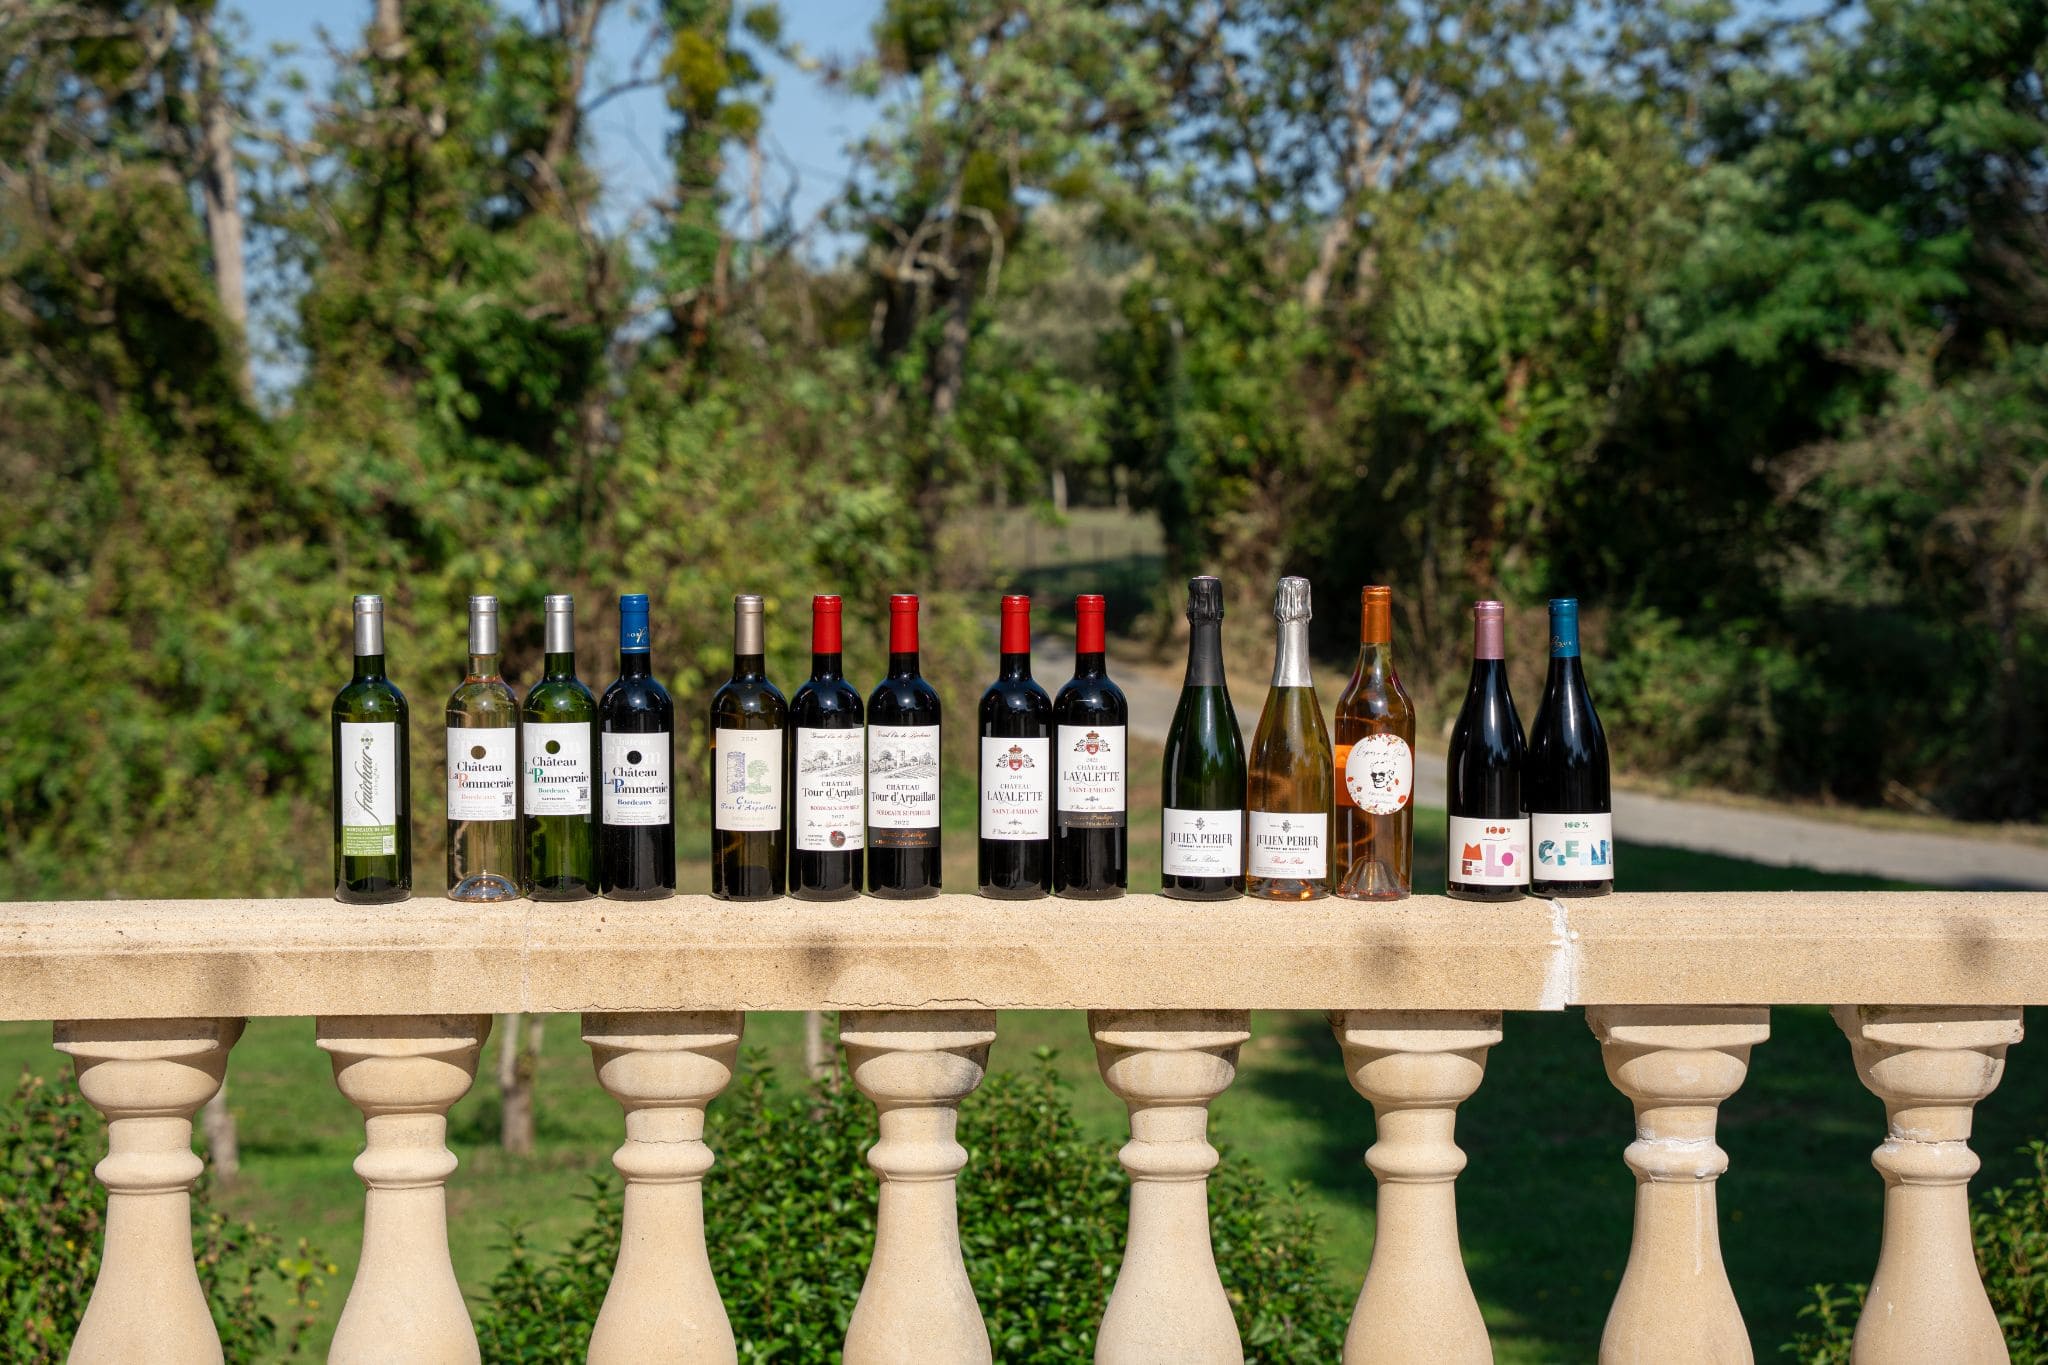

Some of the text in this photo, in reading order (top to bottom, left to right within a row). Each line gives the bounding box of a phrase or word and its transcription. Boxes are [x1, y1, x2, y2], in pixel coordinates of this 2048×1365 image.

[457, 761, 502, 772] Château
[532, 757, 577, 767] Château
[533, 767, 589, 784] Pommeraie
[613, 767, 657, 777] Château
[1063, 771, 1120, 782] LAVALETTE
[458, 773, 513, 789] Pommeraie
[614, 778, 668, 794] Pommeraie
[803, 787, 824, 798] Tour
[872, 791, 889, 802] Tour
[987, 791, 1043, 802] LAVALETTE
[1170, 832, 1233, 847] JULIEN PERIER
[1256, 834, 1319, 848] JULIEN PERIER
